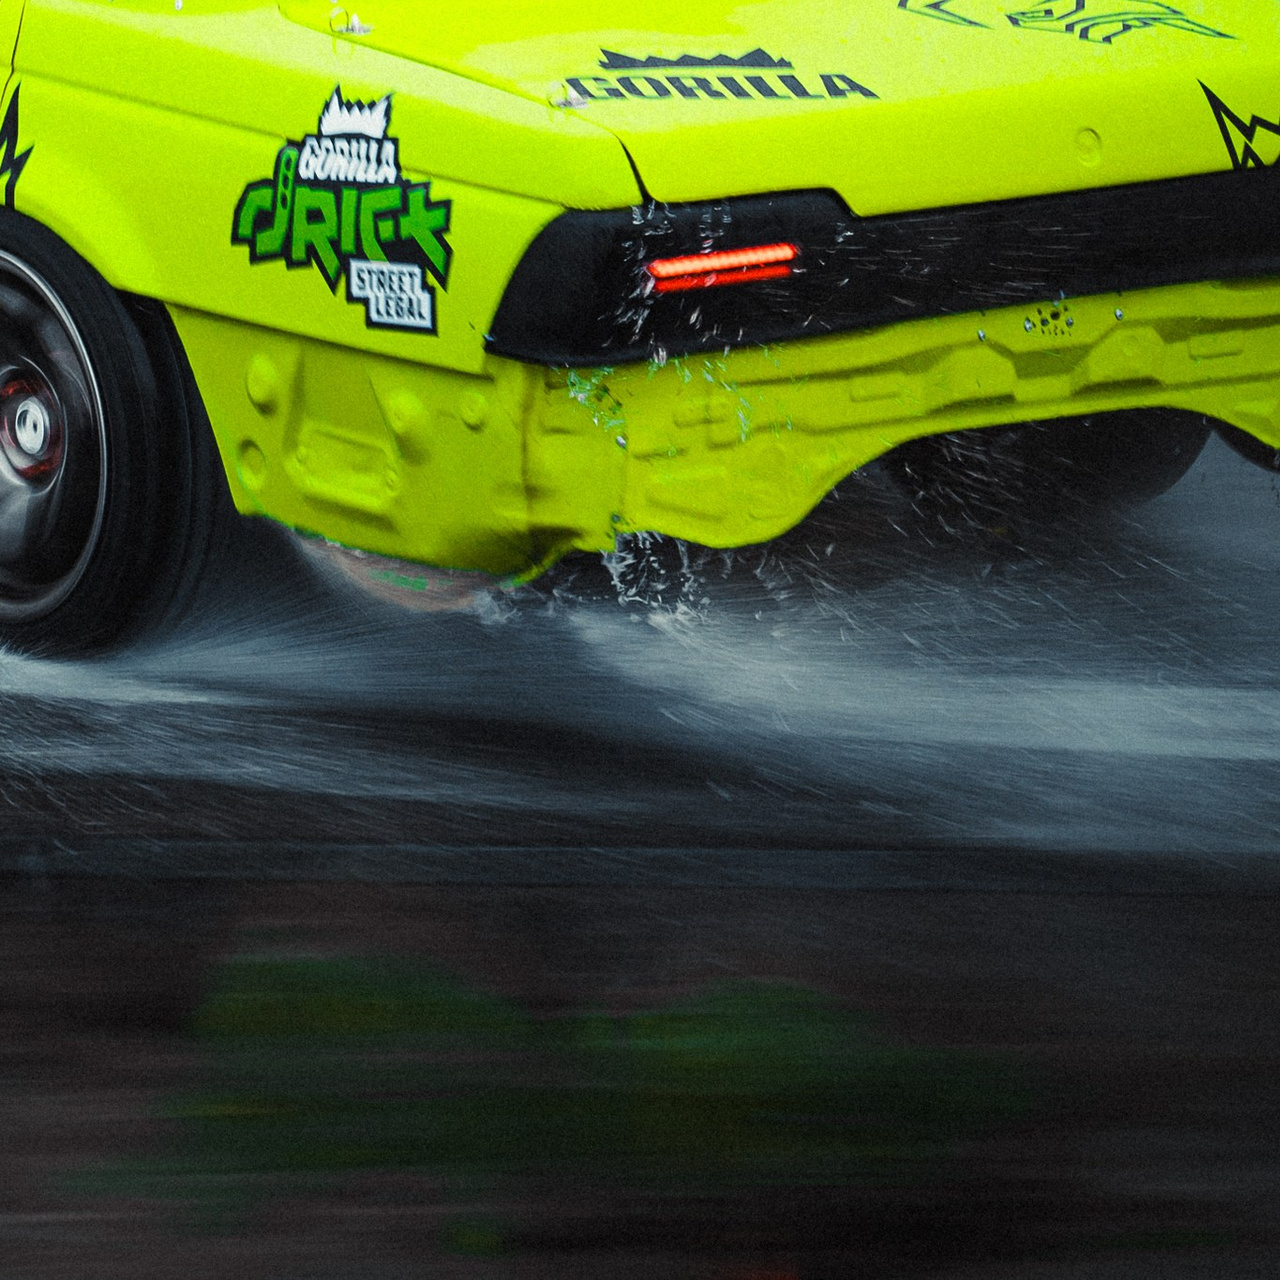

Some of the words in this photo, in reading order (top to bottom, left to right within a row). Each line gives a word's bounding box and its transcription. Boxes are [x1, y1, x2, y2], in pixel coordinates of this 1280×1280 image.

[565, 73, 881, 101] GORILLA
[298, 135, 398, 184] GORILLA
[356, 266, 418, 296] STREET
[374, 293, 428, 321] LEGAL
